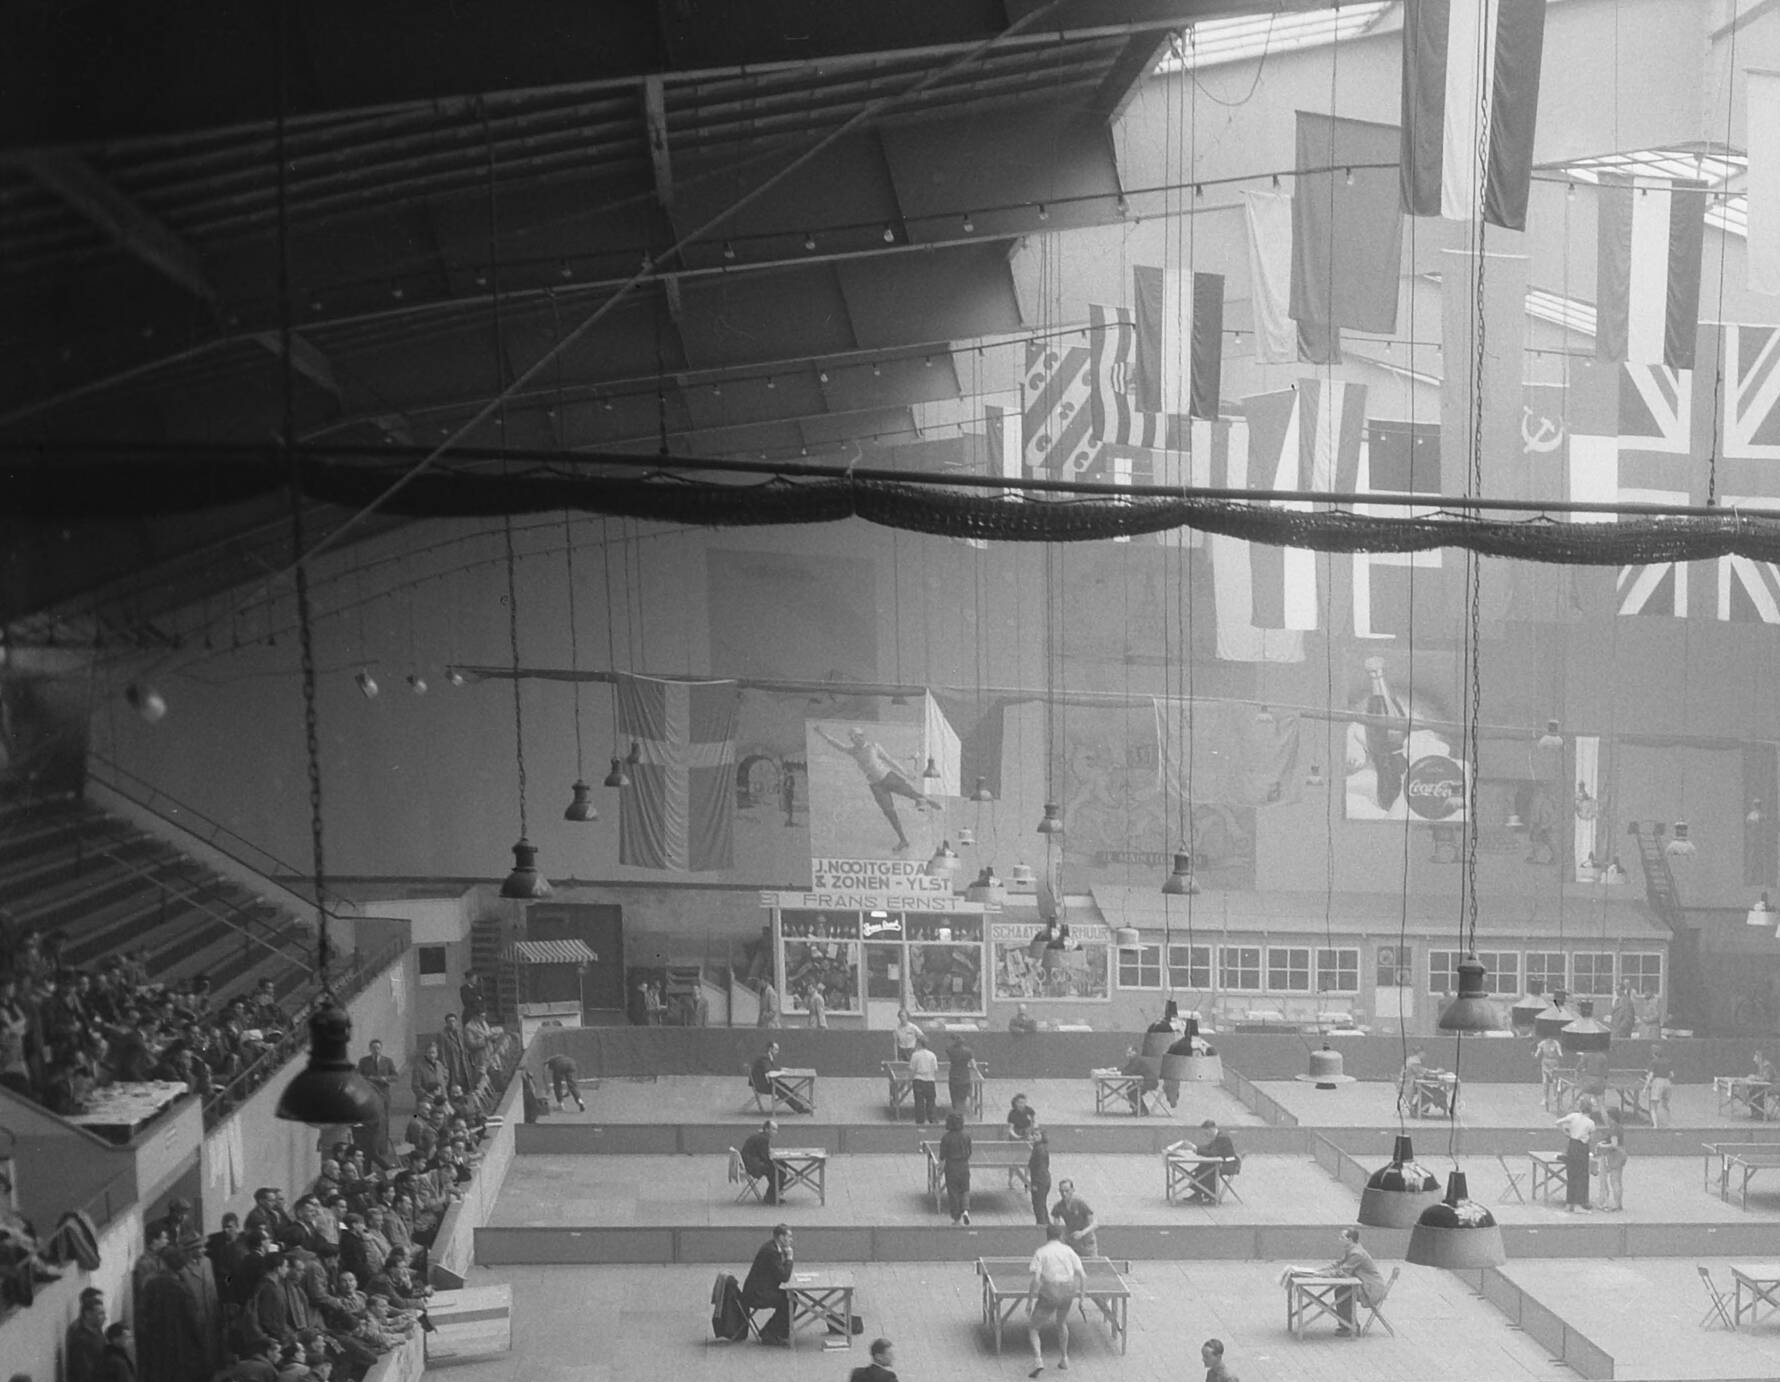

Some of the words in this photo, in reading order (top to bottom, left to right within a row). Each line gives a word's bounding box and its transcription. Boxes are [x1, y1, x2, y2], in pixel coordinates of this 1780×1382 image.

[815, 860, 926, 876] J.NOOITGEDA
[815, 875, 827, 889] &
[831, 876, 890, 890] ZONEN
[906, 877, 951, 892] YLST
[802, 893, 878, 909] FRANS
[887, 896, 961, 911] ERNST
